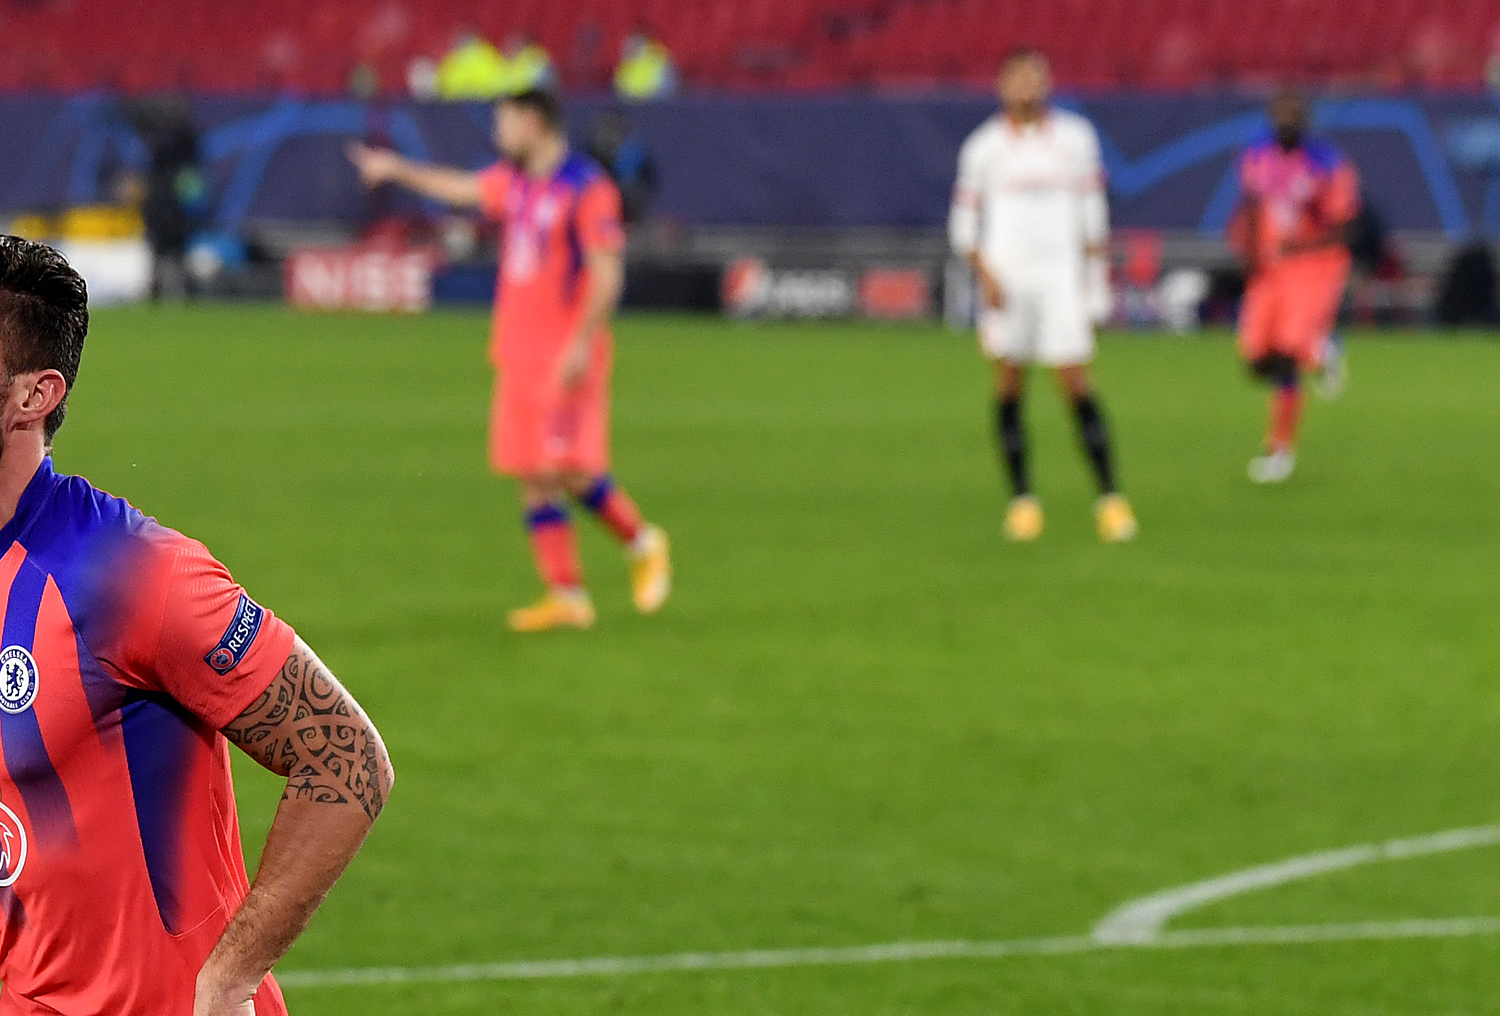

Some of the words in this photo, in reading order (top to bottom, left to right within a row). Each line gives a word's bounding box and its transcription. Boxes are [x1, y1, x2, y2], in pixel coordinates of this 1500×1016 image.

[228, 600, 257, 652] RESPECT
[0, 650, 28, 665] CHELSEA
[20, 691, 32, 706] CLUB
